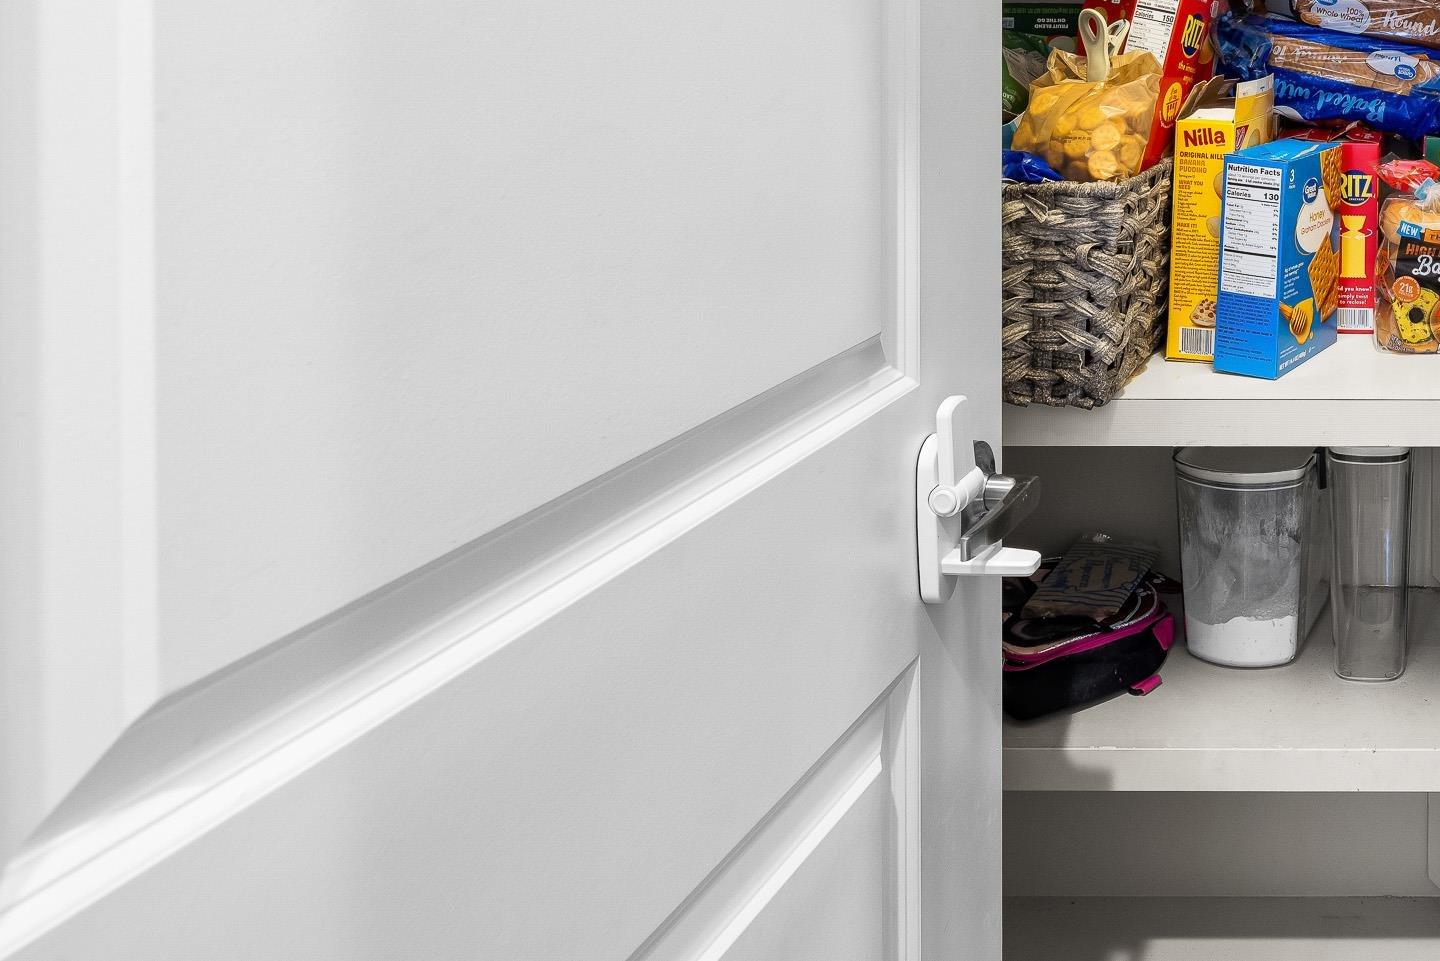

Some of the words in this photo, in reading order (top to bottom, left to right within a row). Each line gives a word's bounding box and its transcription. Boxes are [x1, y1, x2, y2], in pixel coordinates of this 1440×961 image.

[1162, 15, 1174, 23] 150
[1316, 6, 1339, 18] Whole
[1340, 12, 1364, 23] Wheat
[1345, 7, 1365, 18] 100%
[1382, 10, 1437, 36] Round
[1182, 15, 1205, 49] RITZ
[1316, 90, 1386, 123] Baked
[1183, 127, 1226, 148] Nilla
[1179, 151, 1209, 160] ORIGINAL
[1209, 152, 1224, 160] NILL
[1179, 166, 1207, 174] PUDDING
[1227, 164, 1259, 174] Nutrition
[1260, 168, 1281, 177] Facts
[1289, 168, 1295, 182] 3
[1341, 174, 1372, 198] RITZ
[1263, 192, 1279, 201] 130
[1309, 209, 1326, 222] Honey
[1400, 223, 1419, 236] NEW
[1405, 243, 1436, 257] HIGH
